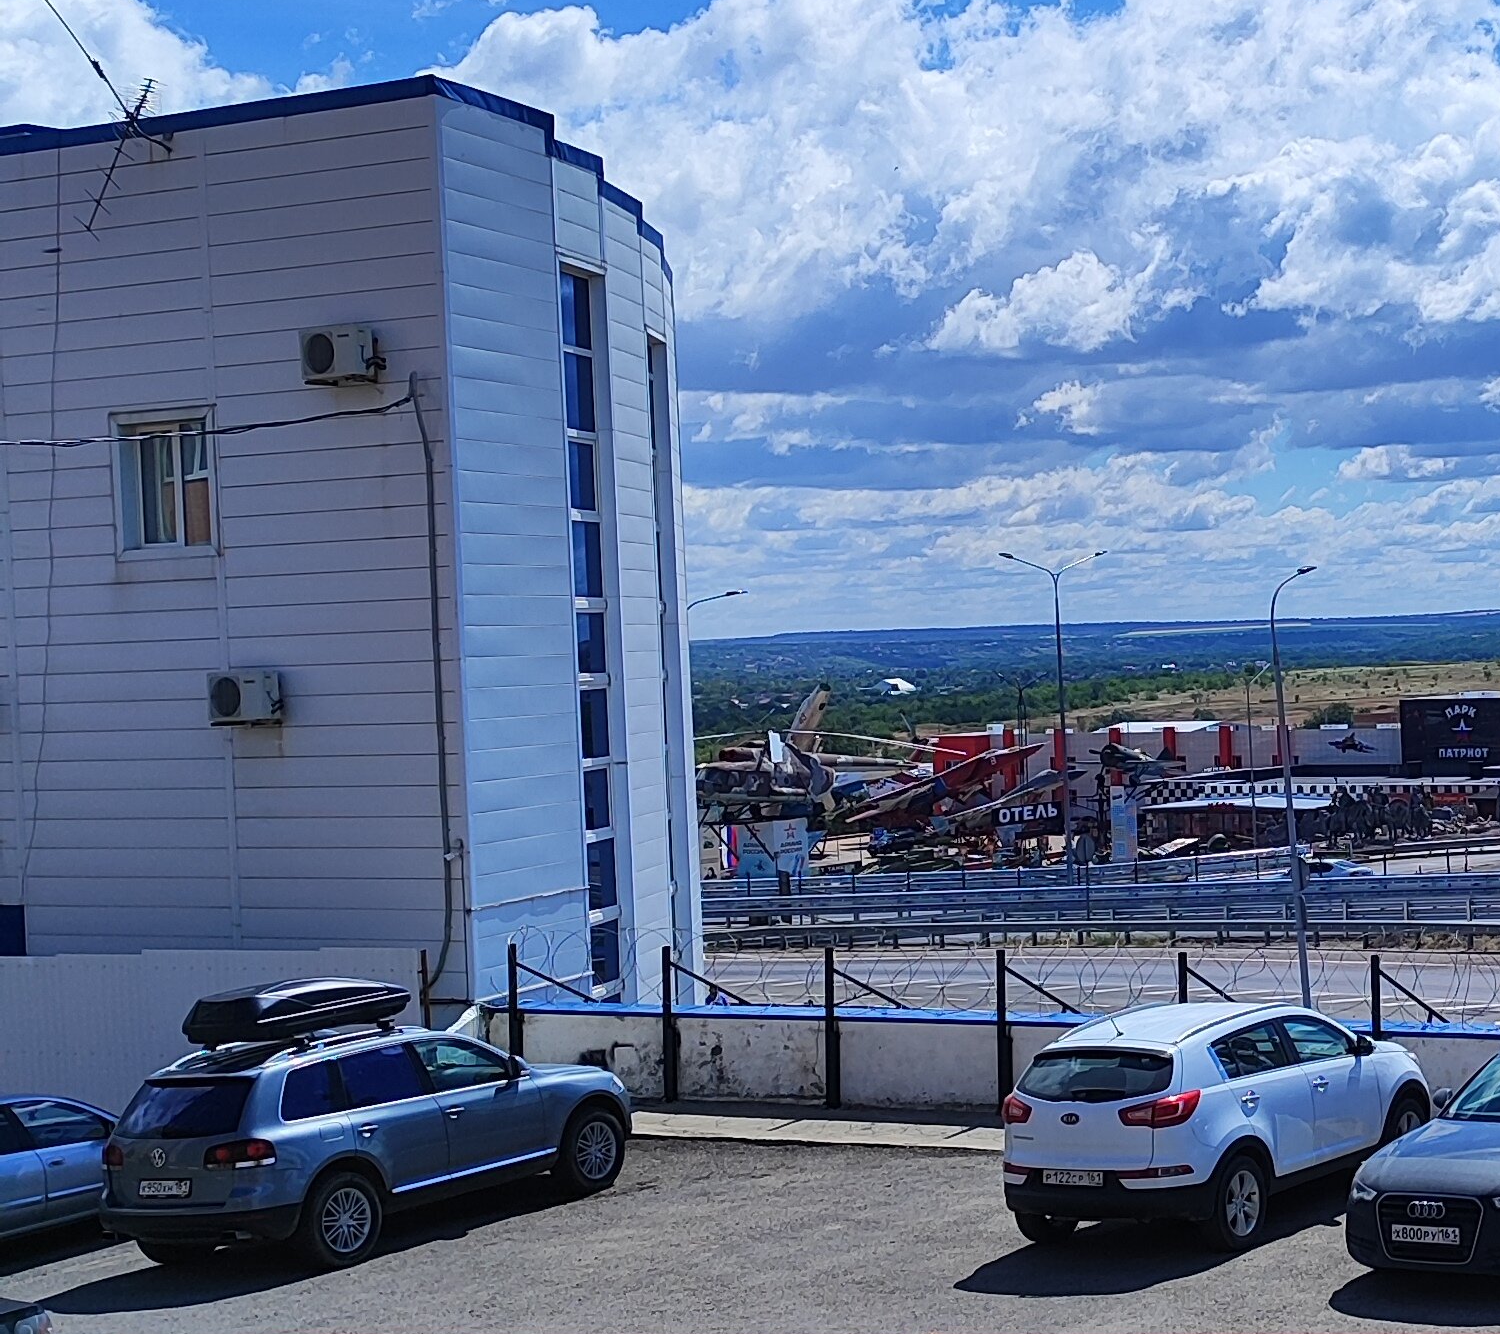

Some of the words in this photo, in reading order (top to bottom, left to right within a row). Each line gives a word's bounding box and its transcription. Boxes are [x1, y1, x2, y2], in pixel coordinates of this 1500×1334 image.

[1444, 704, 1477, 719] ПАРК
[1438, 747, 1489, 758] ПАТРИОТ
[998, 803, 1058, 823] ОТЕЛЬ
